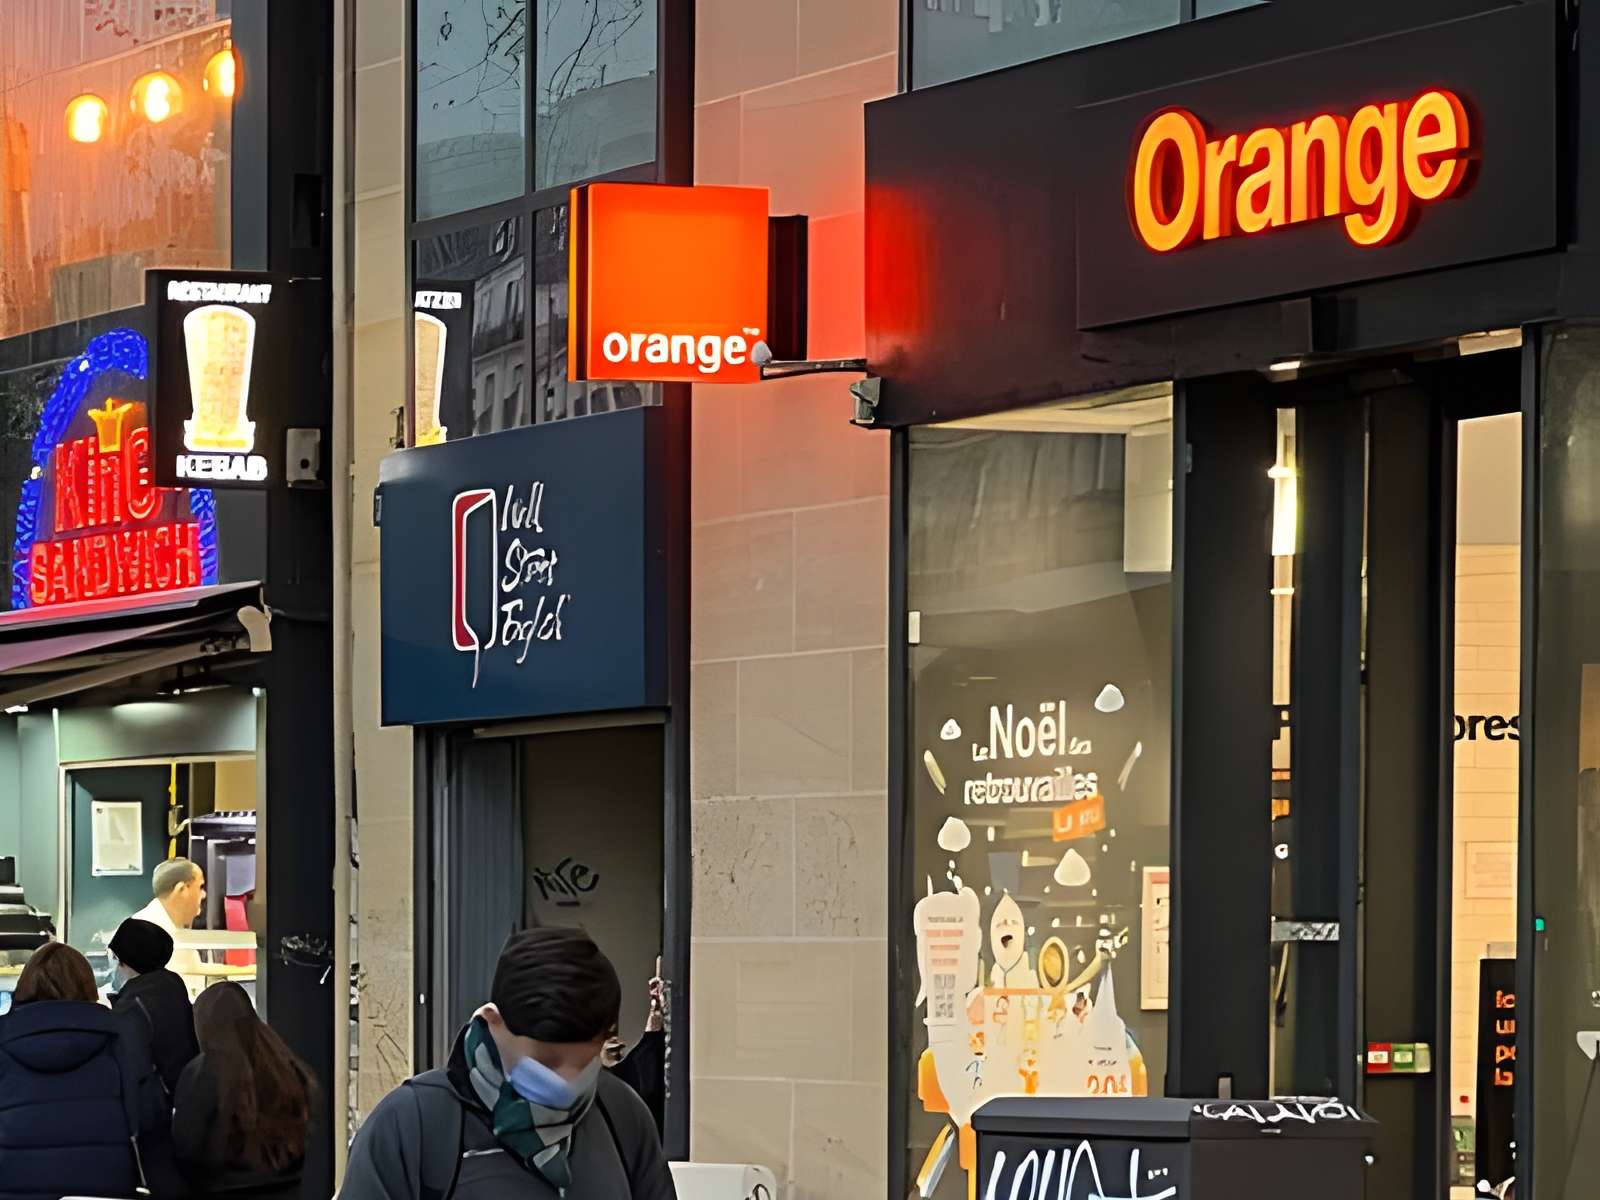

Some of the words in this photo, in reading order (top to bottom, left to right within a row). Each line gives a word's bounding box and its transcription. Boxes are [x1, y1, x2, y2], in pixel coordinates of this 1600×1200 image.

[1133, 90, 1467, 252] Orange
[603, 331, 747, 374] orange
[30, 523, 202, 604] SANDWICH
[990, 699, 1066, 760] Noël
